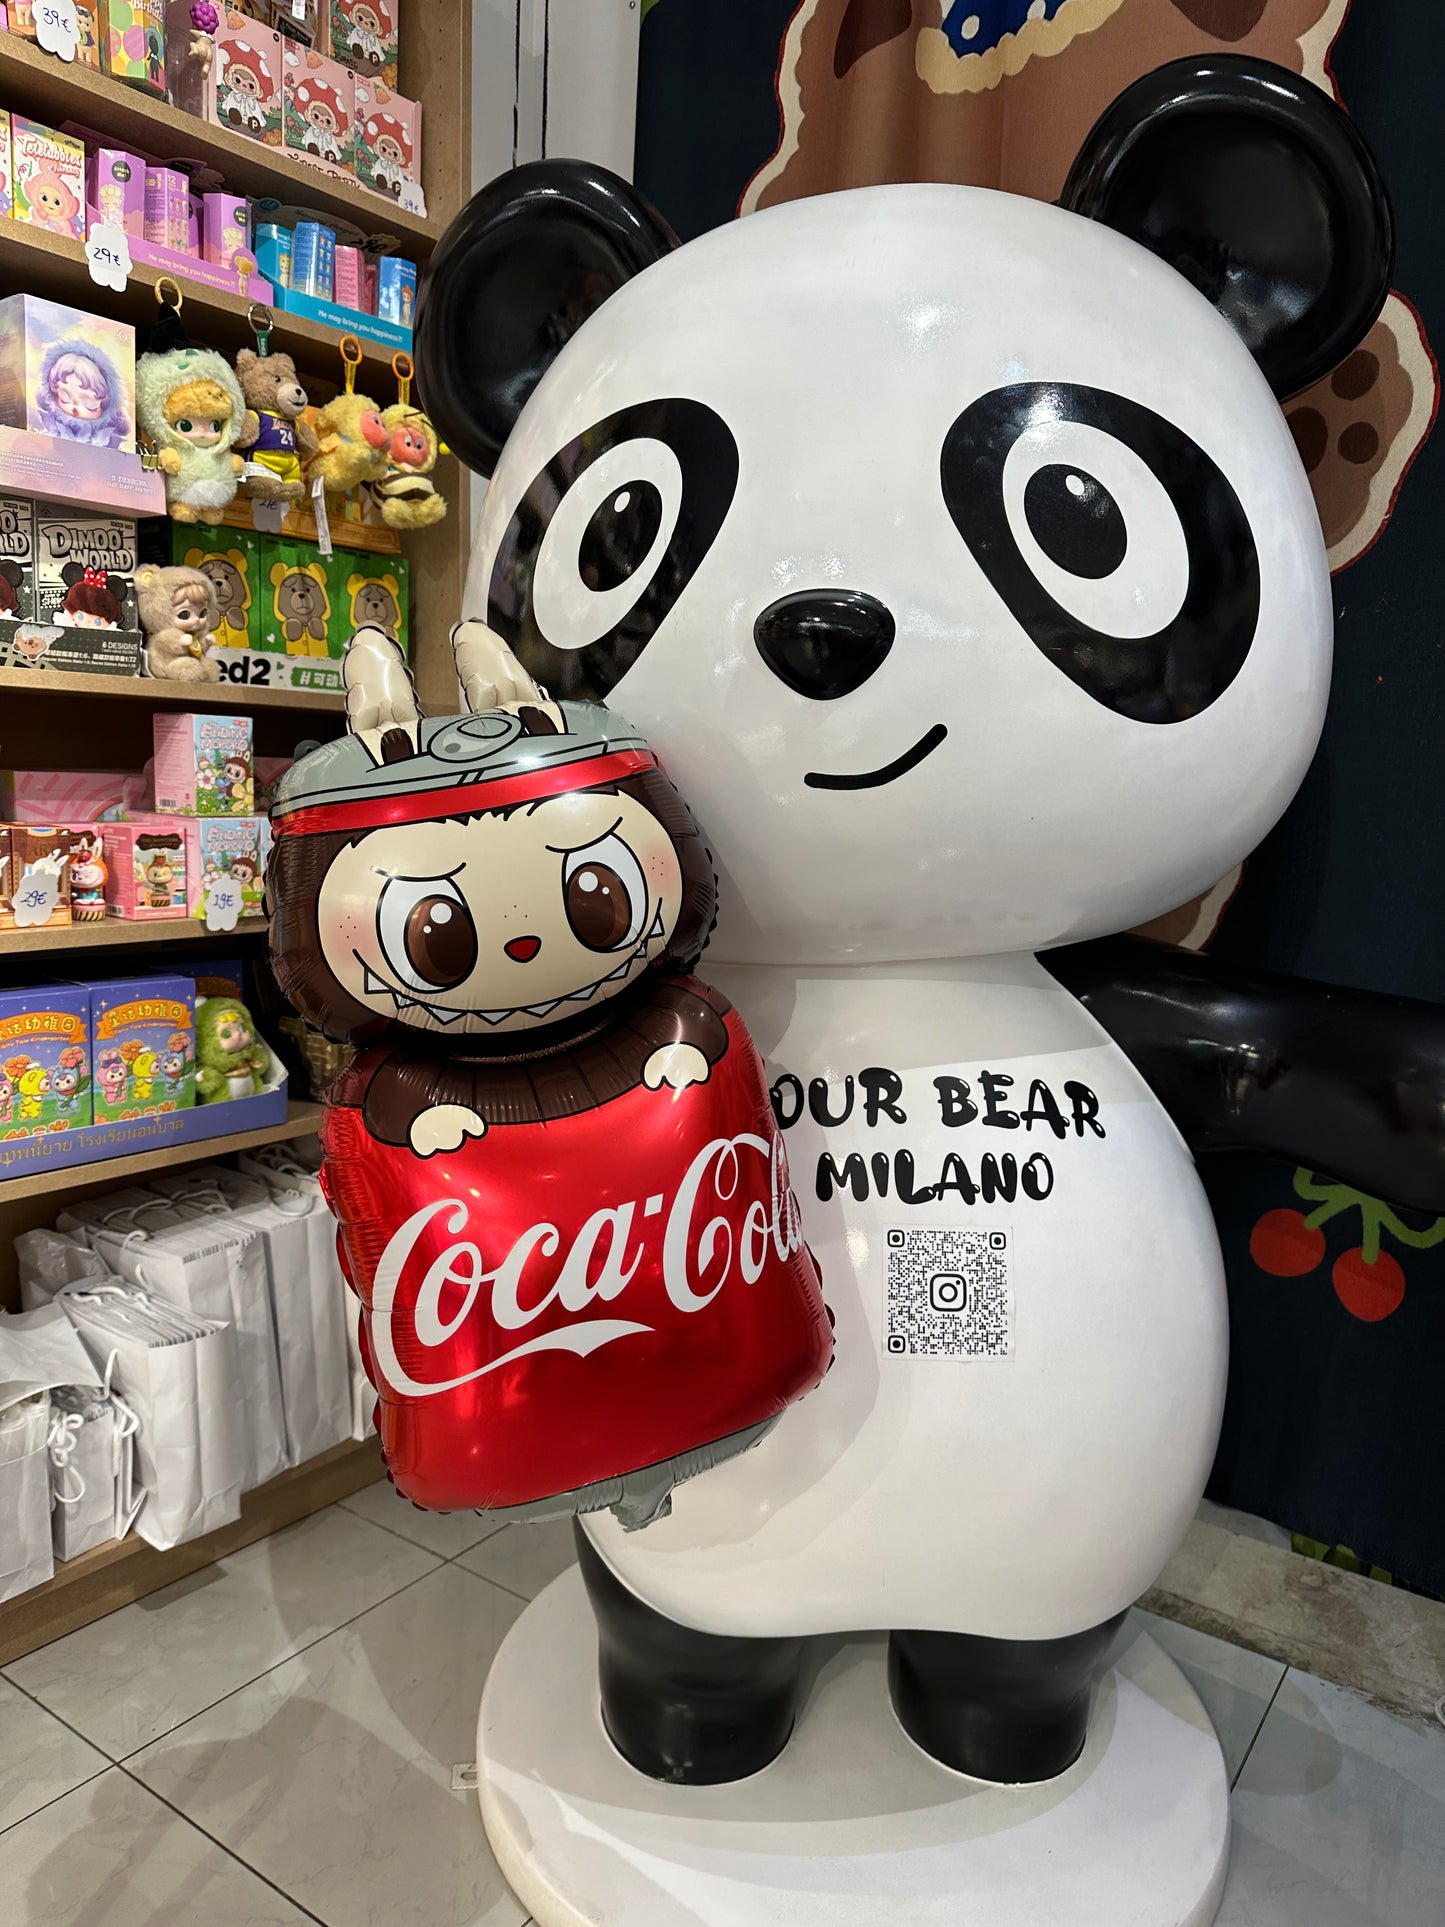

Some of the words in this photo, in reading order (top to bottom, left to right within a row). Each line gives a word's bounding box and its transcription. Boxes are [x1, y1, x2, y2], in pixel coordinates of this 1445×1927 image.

[42, 7, 71, 33] 39€
[19, 133, 82, 168] Teletubbies
[403, 199, 419, 214] 39€
[93, 247, 121, 267] 29€
[148, 253, 158, 262] He
[158, 257, 172, 269] may
[172, 261, 189, 274] bring
[189, 267, 202, 278] you
[318, 309, 328, 319] He
[328, 313, 342, 325] may
[342, 316, 359, 331] bring
[358, 323, 371, 334] you
[280, 429, 293, 446] 24
[41, 524, 123, 558] DIMOO
[69, 547, 134, 573] WORLD
[102, 641, 107, 649] 6
[107, 642, 138, 651] DESIGNS
[200, 724, 248, 739] FINDING
[201, 738, 248, 751] MOKOKO
[207, 827, 255, 841] FINDING
[207, 840, 255, 852] MOKOKO
[20, 889, 48, 908] 29€
[213, 893, 234, 909] 19€
[108, 1003, 183, 1028] 童话幼稚园
[114, 1025, 130, 1035] Fairy
[138, 1021, 177, 1029] Kindergarten
[15, 1038, 30, 1046] Tale
[30, 1035, 70, 1043] Kindergarten
[932, 1069, 1107, 1140] BEAR
[815, 1148, 1054, 1206] MILANO
[372, 1129, 805, 1397] Coca-Cola
